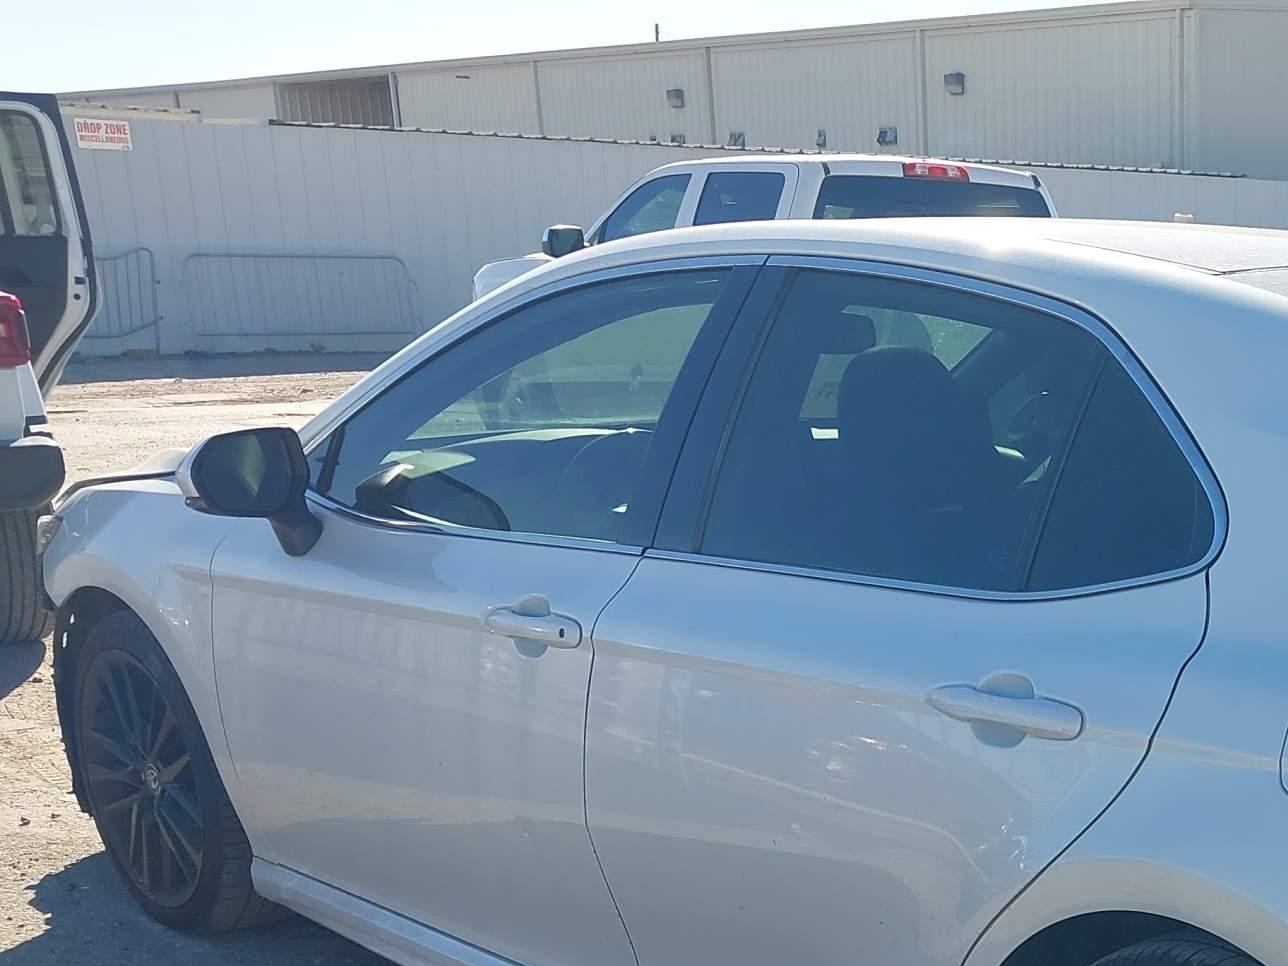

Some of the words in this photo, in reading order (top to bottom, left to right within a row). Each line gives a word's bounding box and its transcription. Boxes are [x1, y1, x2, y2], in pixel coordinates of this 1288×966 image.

[76, 121, 102, 134] DROP
[104, 123, 128, 135] ZONE
[79, 134, 129, 145] MISCELLANEOUS
